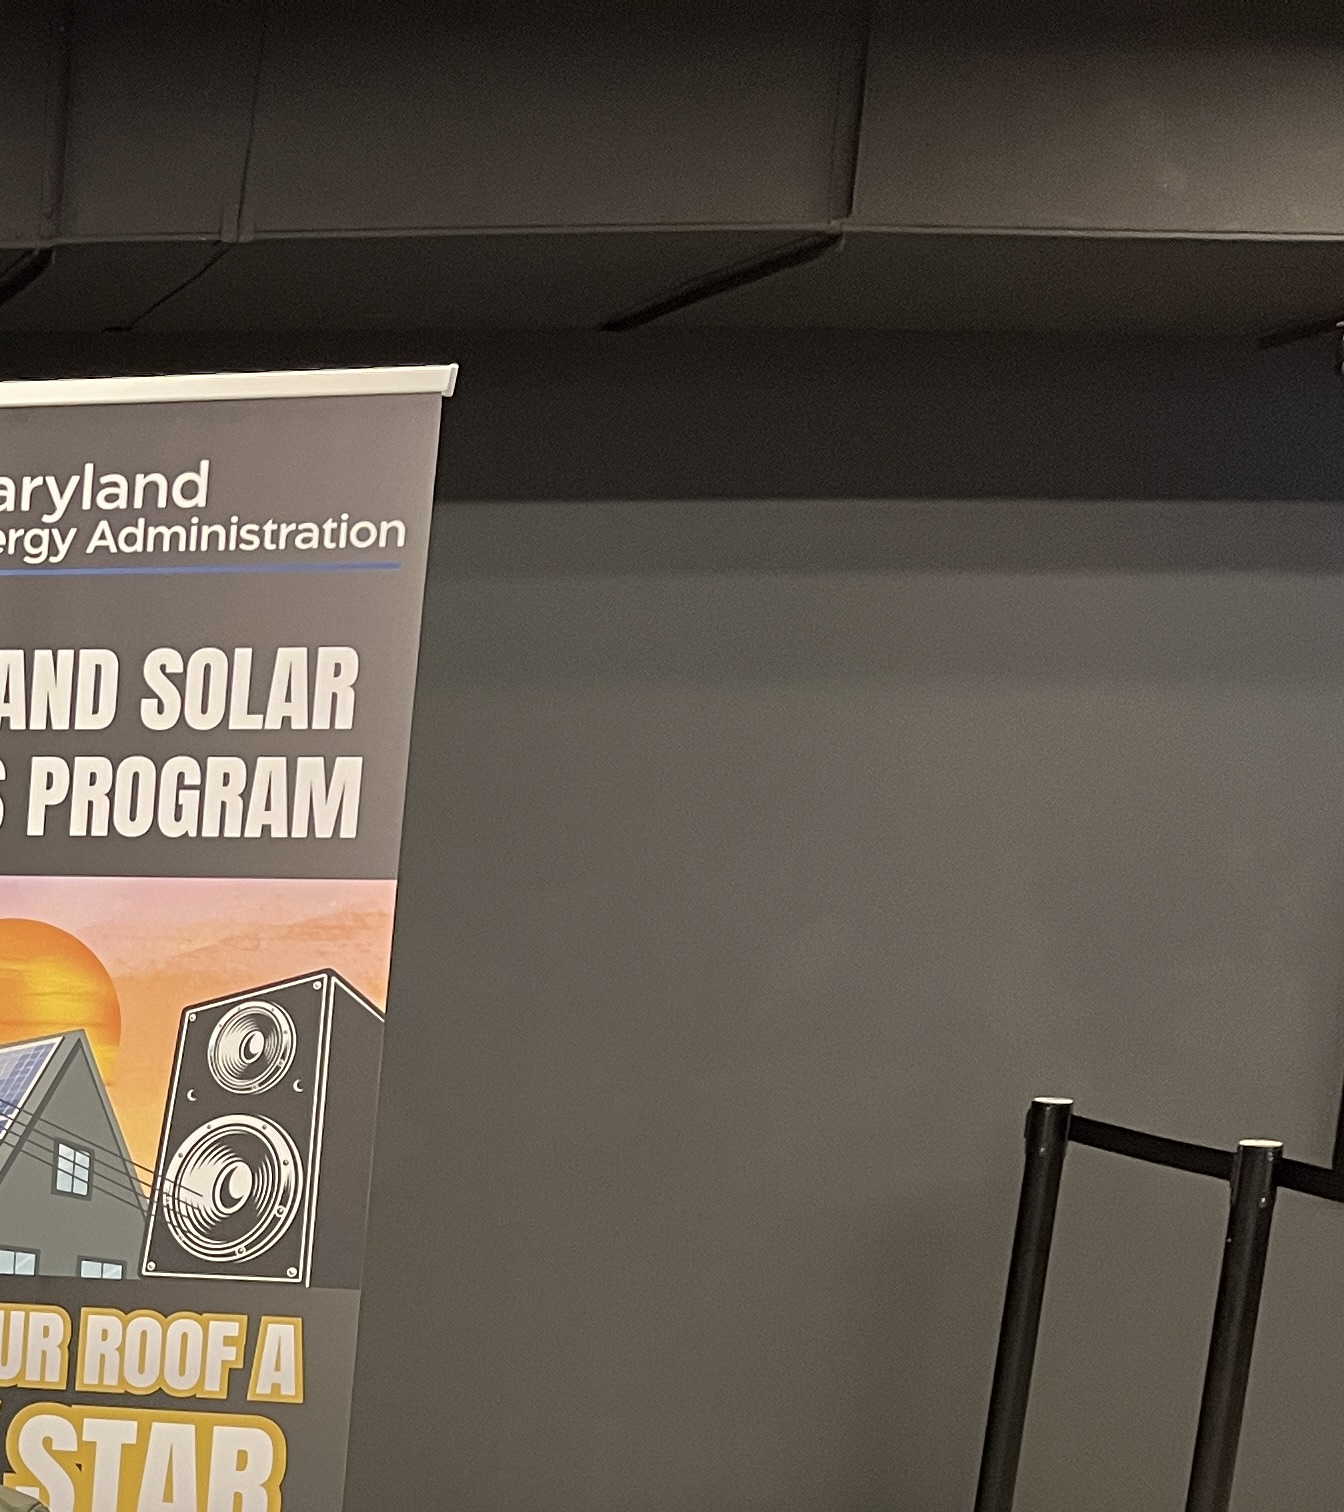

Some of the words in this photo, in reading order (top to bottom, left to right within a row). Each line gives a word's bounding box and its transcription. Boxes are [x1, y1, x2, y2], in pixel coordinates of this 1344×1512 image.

[86, 514, 406, 555] Administration
[140, 646, 359, 731] SOLAR
[25, 756, 364, 839] PROGRAM
[82, 1311, 242, 1395] ROOF
[254, 1321, 300, 1400] A
